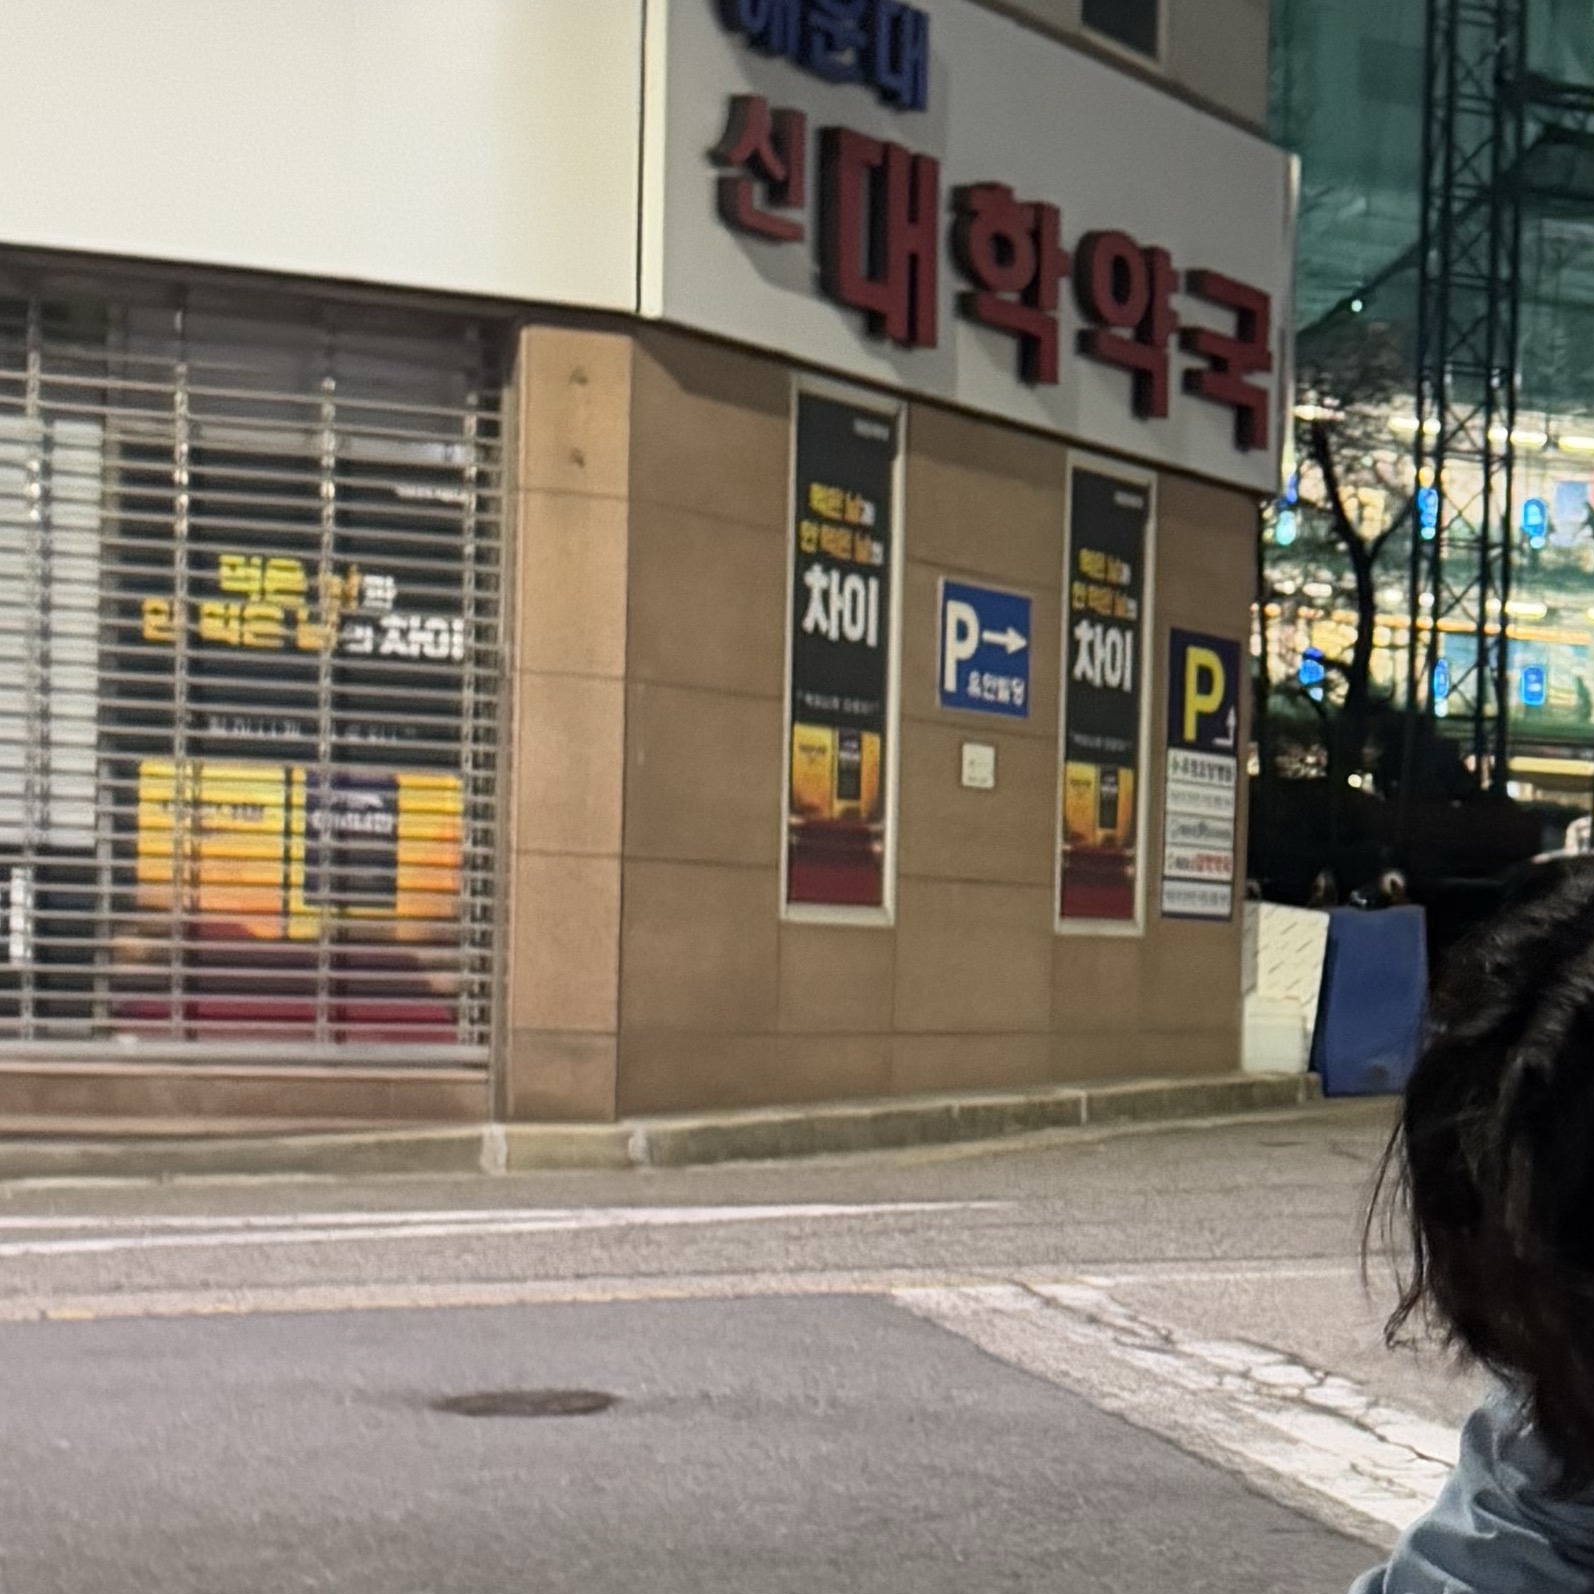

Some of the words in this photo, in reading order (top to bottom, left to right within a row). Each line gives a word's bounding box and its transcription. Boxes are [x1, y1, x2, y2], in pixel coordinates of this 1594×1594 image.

[706, 93, 1272, 450] 신대학약국
[379, 613, 465, 660] 차이
[802, 562, 880, 648] 차이
[944, 599, 979, 693] P
[1073, 619, 1134, 694] 차이
[1183, 645, 1225, 742] P
